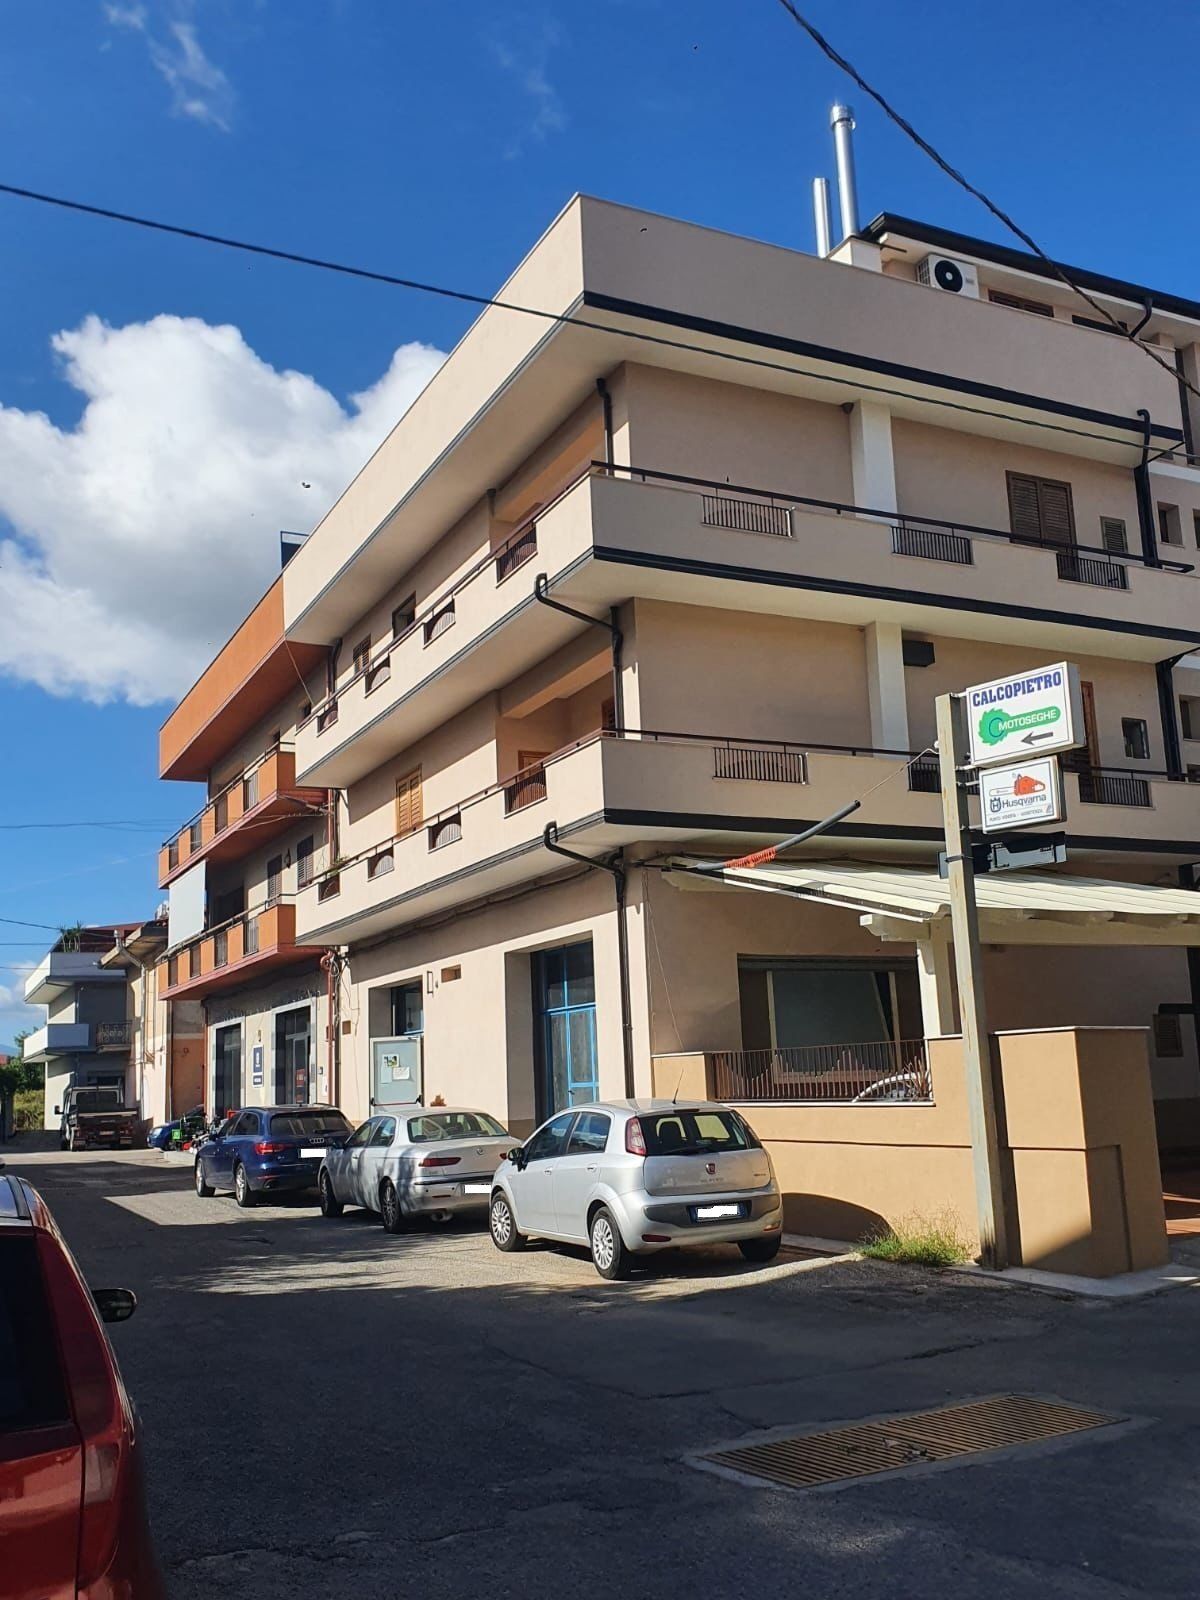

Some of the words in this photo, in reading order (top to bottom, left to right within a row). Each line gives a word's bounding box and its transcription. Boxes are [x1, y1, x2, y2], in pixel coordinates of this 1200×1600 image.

[972, 671, 1062, 707] CALCOPIETRO
[998, 709, 1057, 731] MOTOSEGHE
[1002, 794, 1047, 809] Husqvarna
